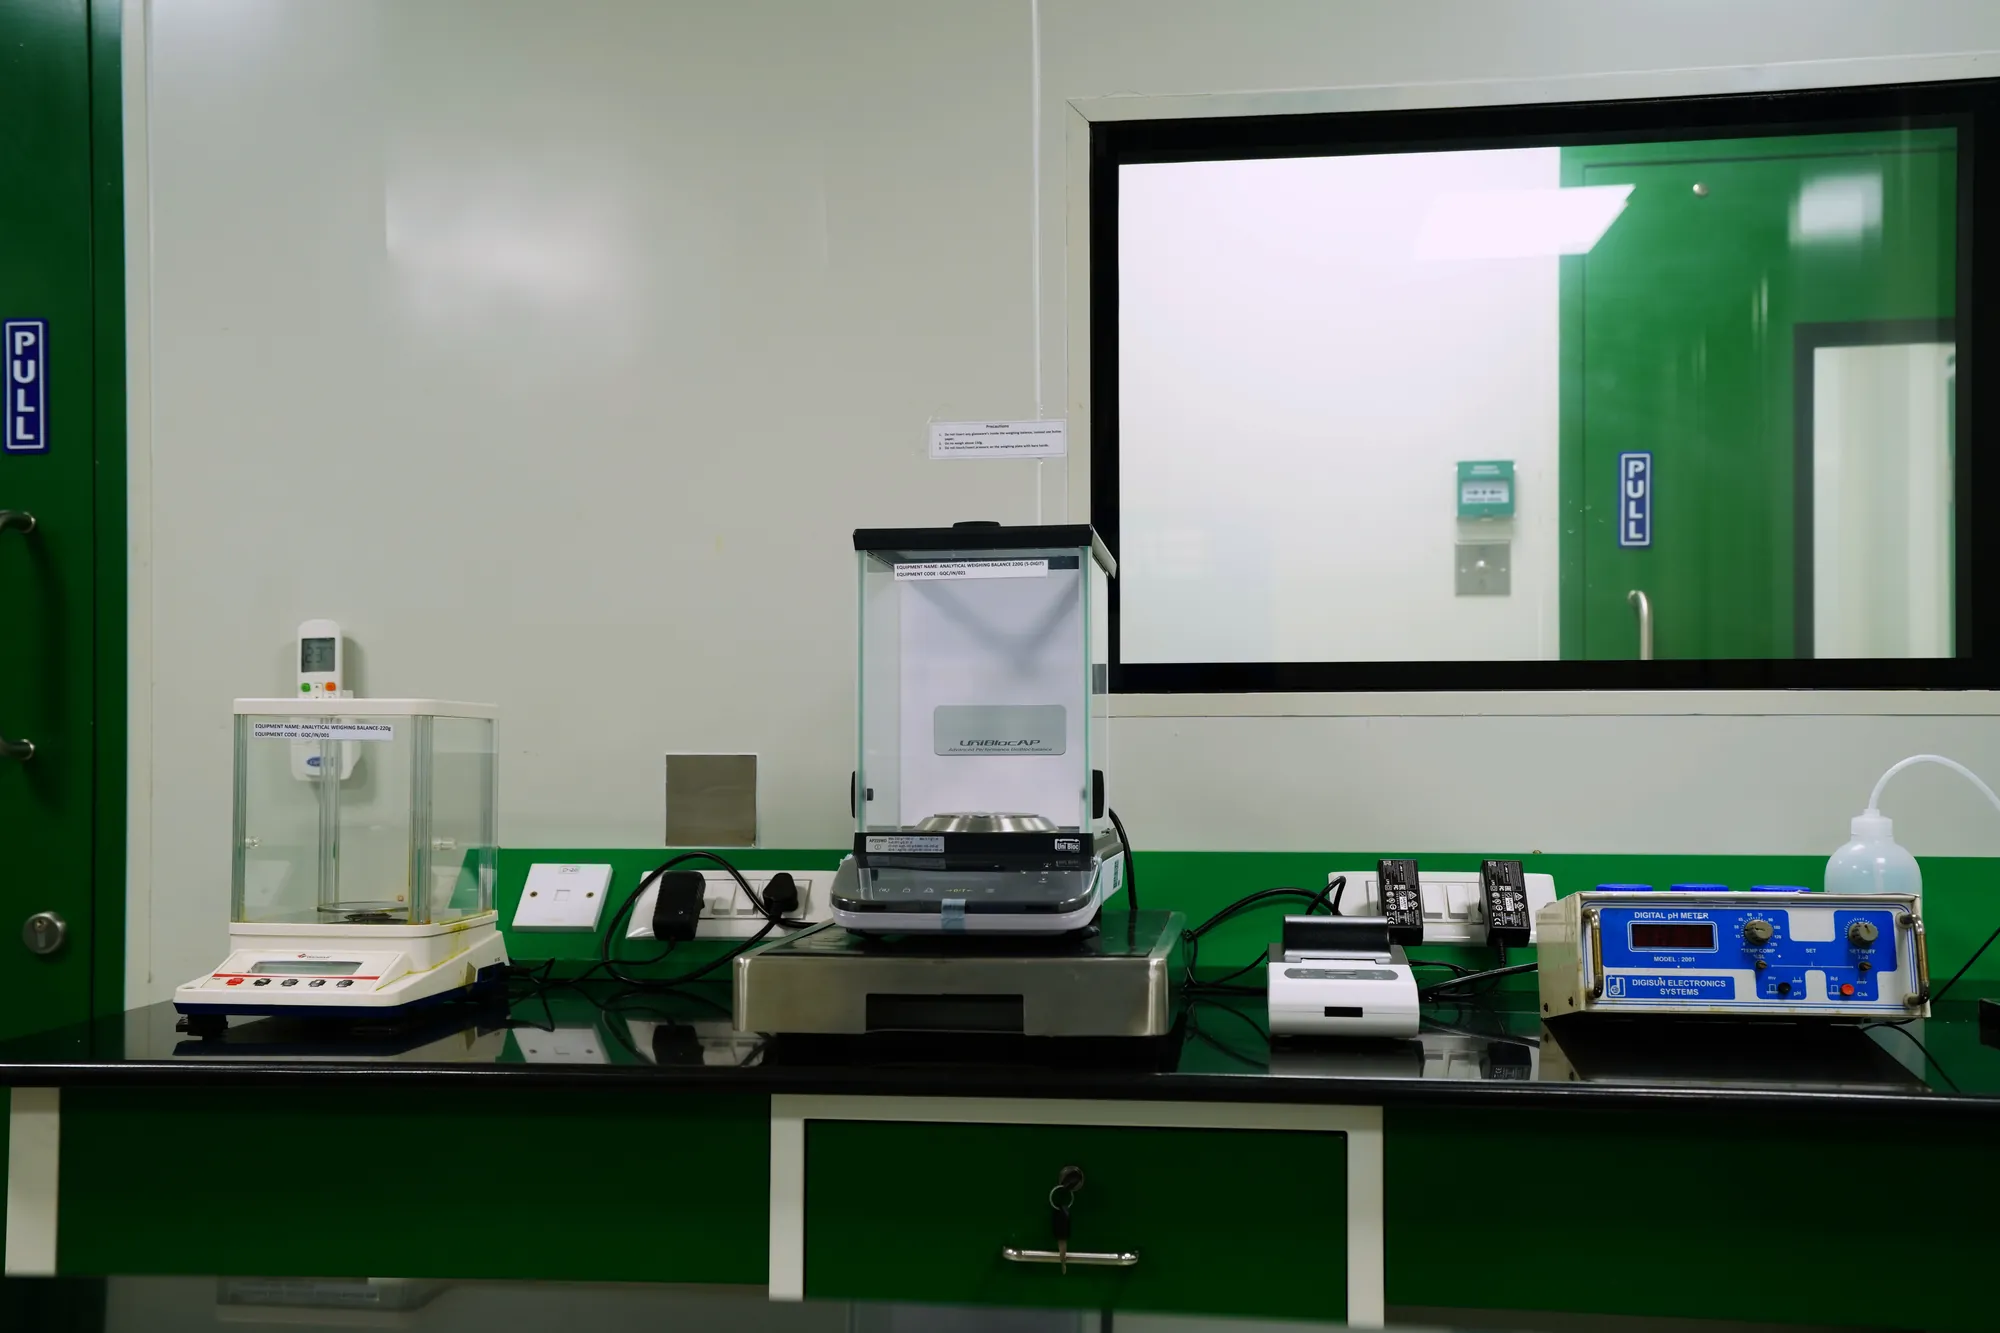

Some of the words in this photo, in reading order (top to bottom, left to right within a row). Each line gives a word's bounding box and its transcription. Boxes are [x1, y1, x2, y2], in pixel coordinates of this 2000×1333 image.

[13, 331, 36, 440] PULL
[1626, 460, 1645, 539] PULL
[1668, 912, 1679, 920] pH
